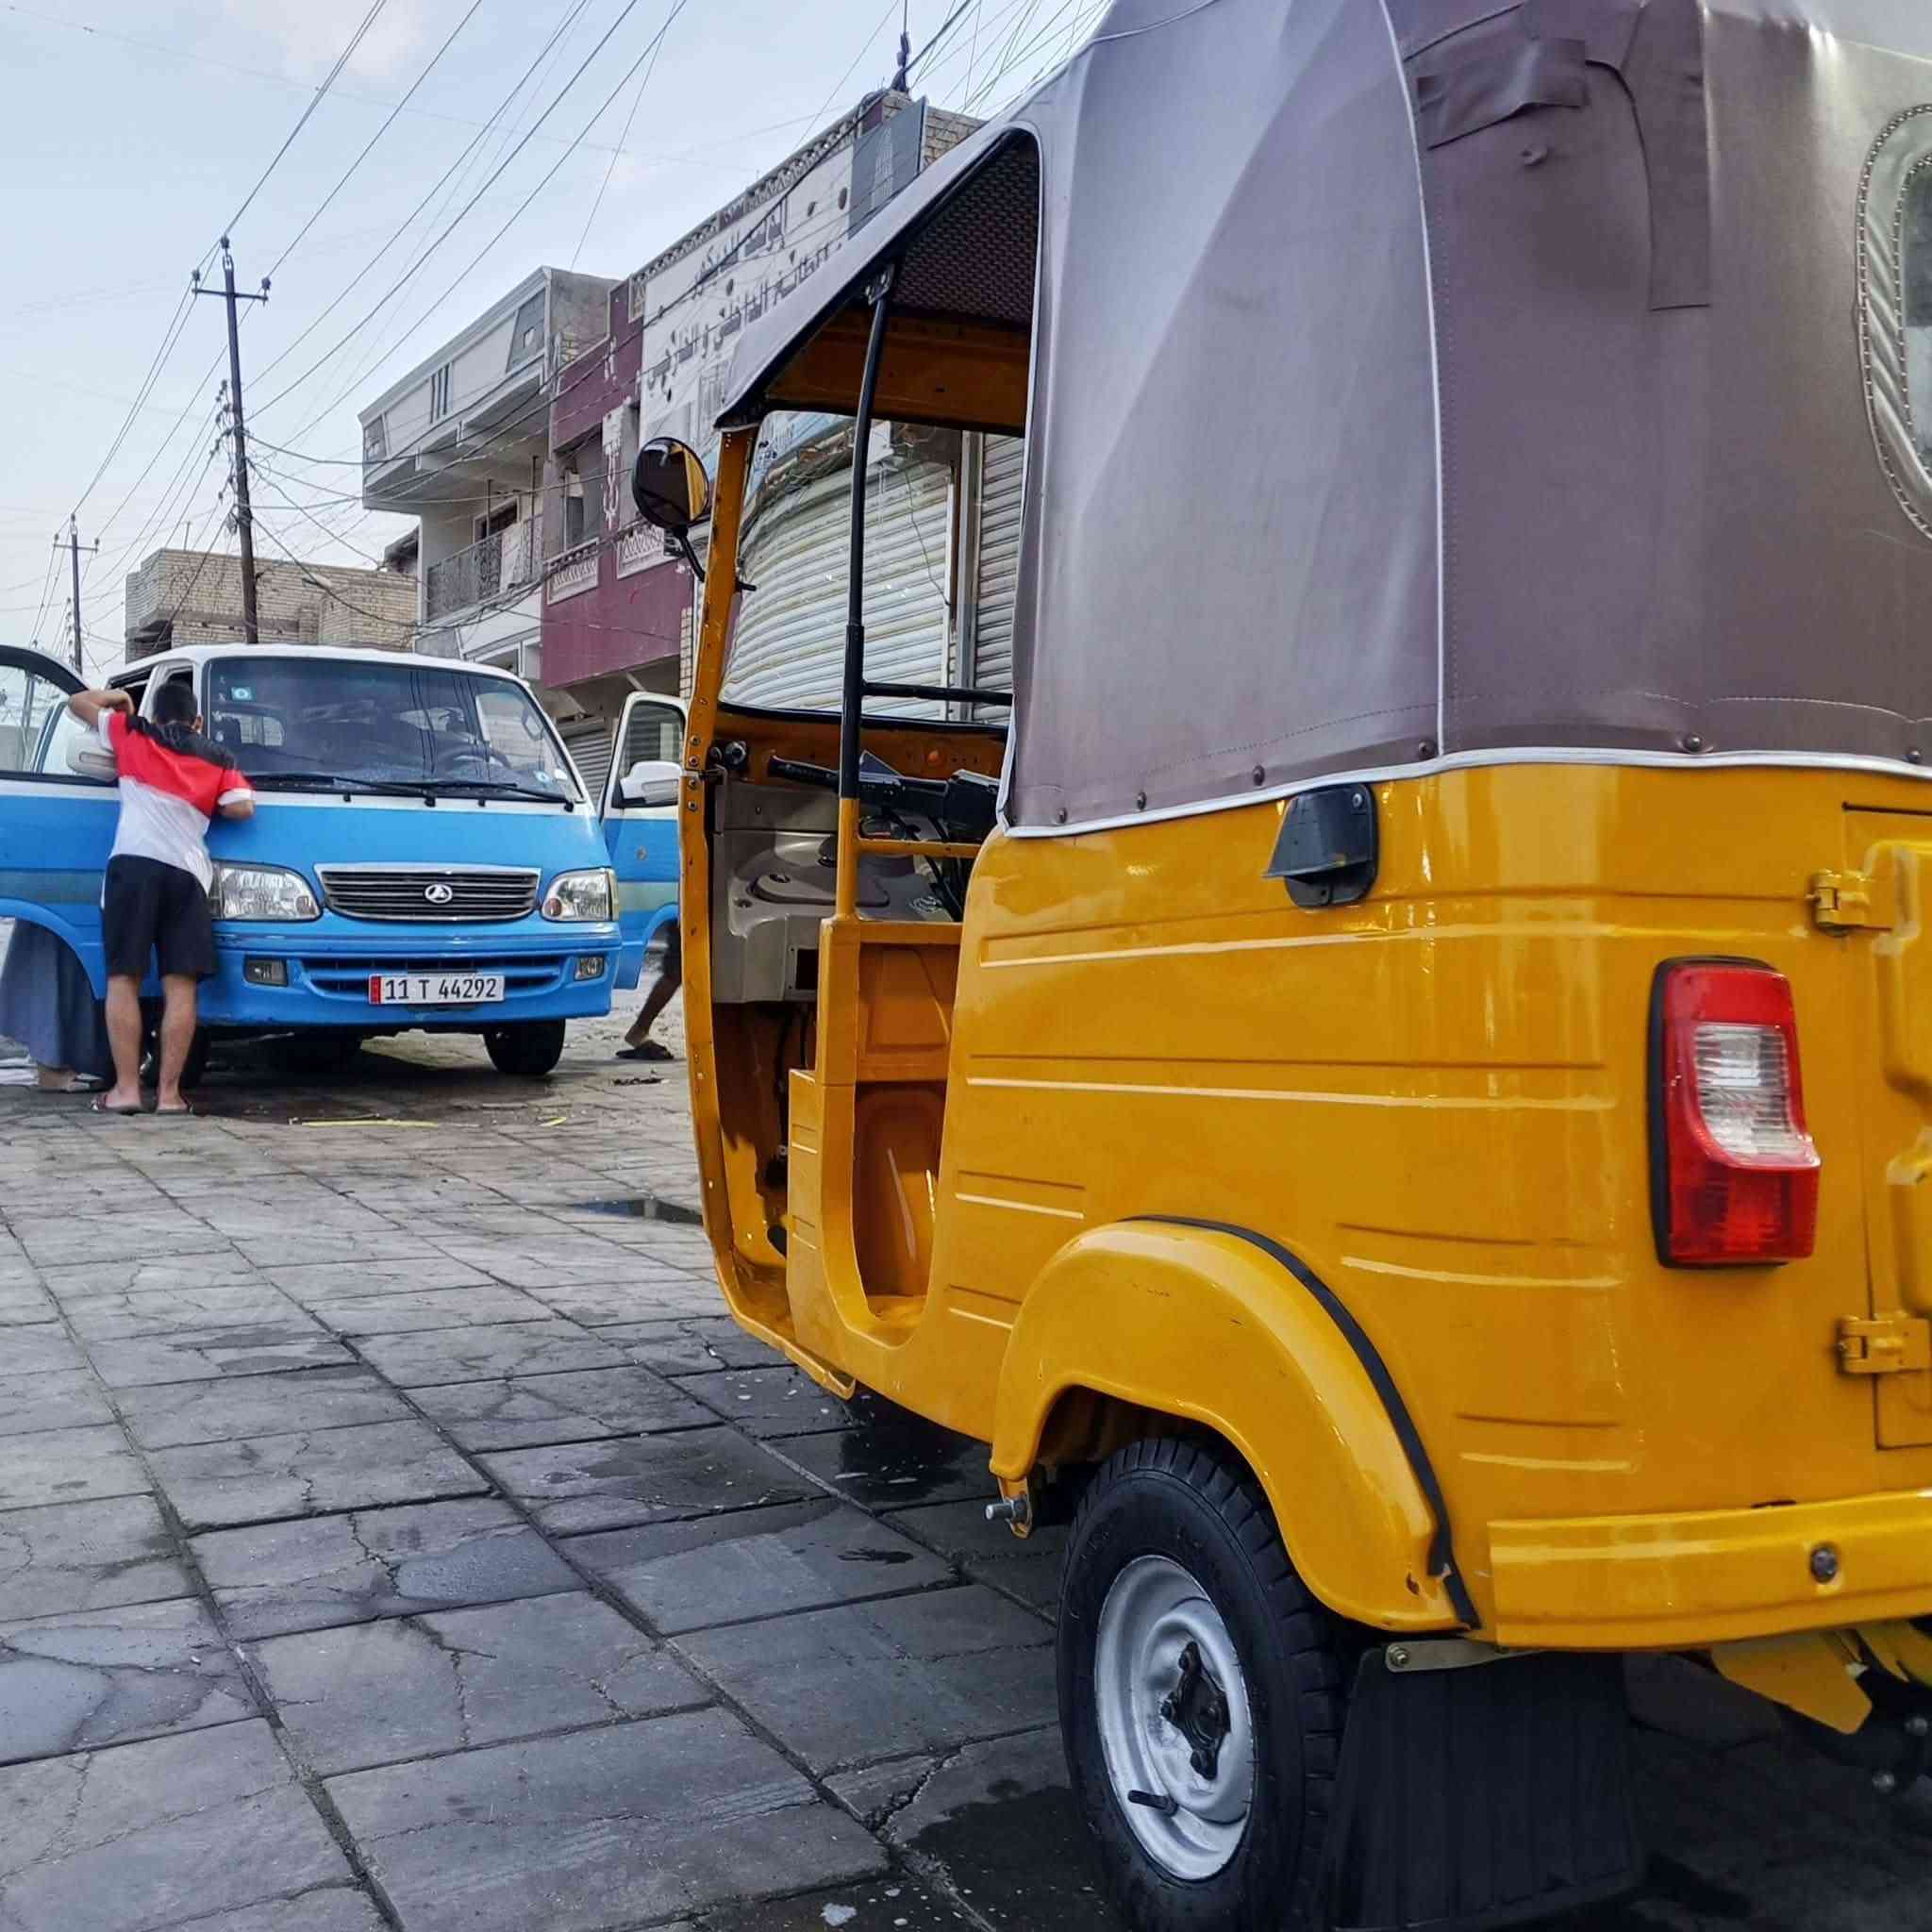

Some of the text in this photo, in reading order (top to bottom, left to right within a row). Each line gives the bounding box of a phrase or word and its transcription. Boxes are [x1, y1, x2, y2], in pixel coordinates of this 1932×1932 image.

[385, 979, 409, 1000] 11
[418, 978, 430, 1000] T
[438, 977, 497, 1000] 44292
